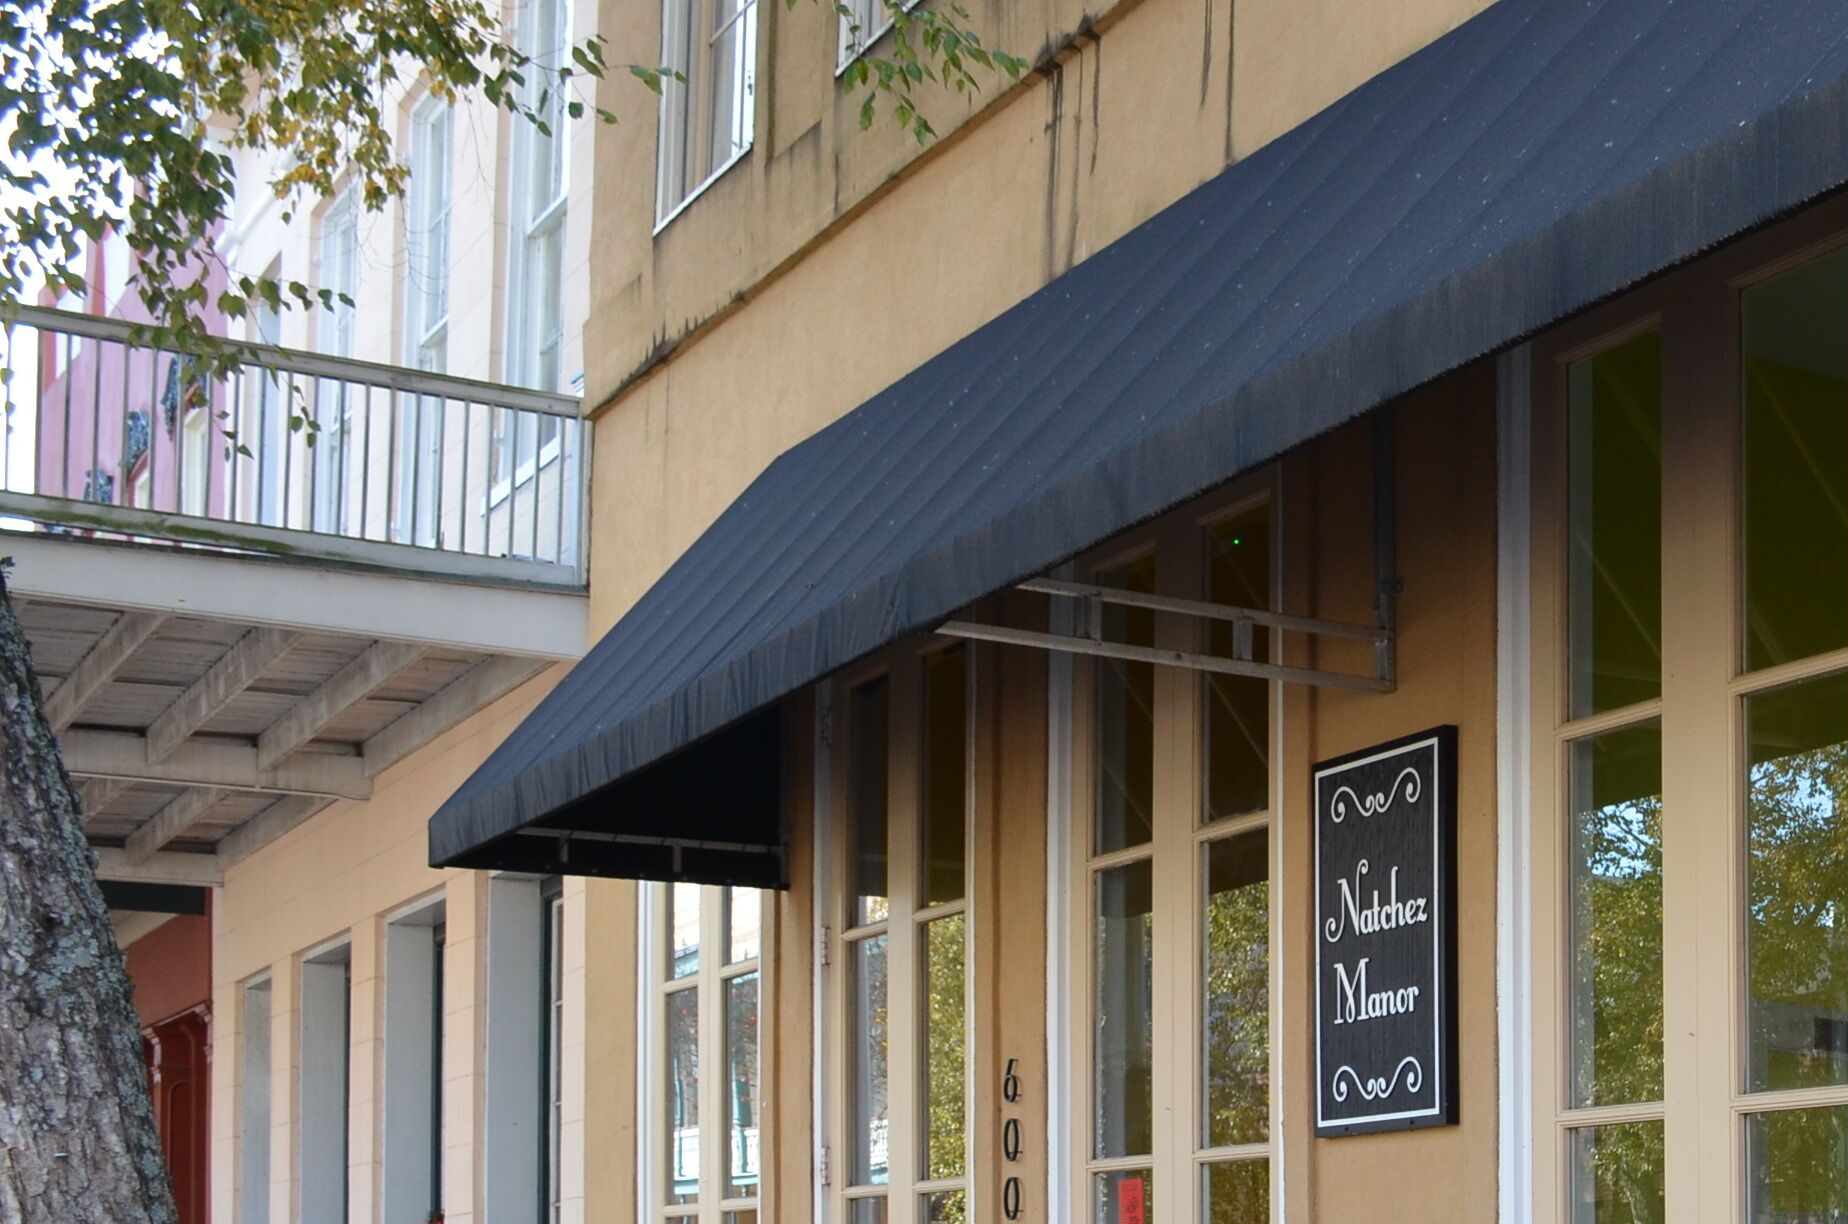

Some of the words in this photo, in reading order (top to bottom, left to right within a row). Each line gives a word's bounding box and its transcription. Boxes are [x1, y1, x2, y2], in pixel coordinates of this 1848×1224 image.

[1325, 858, 1428, 943] Natchez
[1333, 957, 1420, 1025] Manor
[1003, 1057, 1023, 1221] 600
